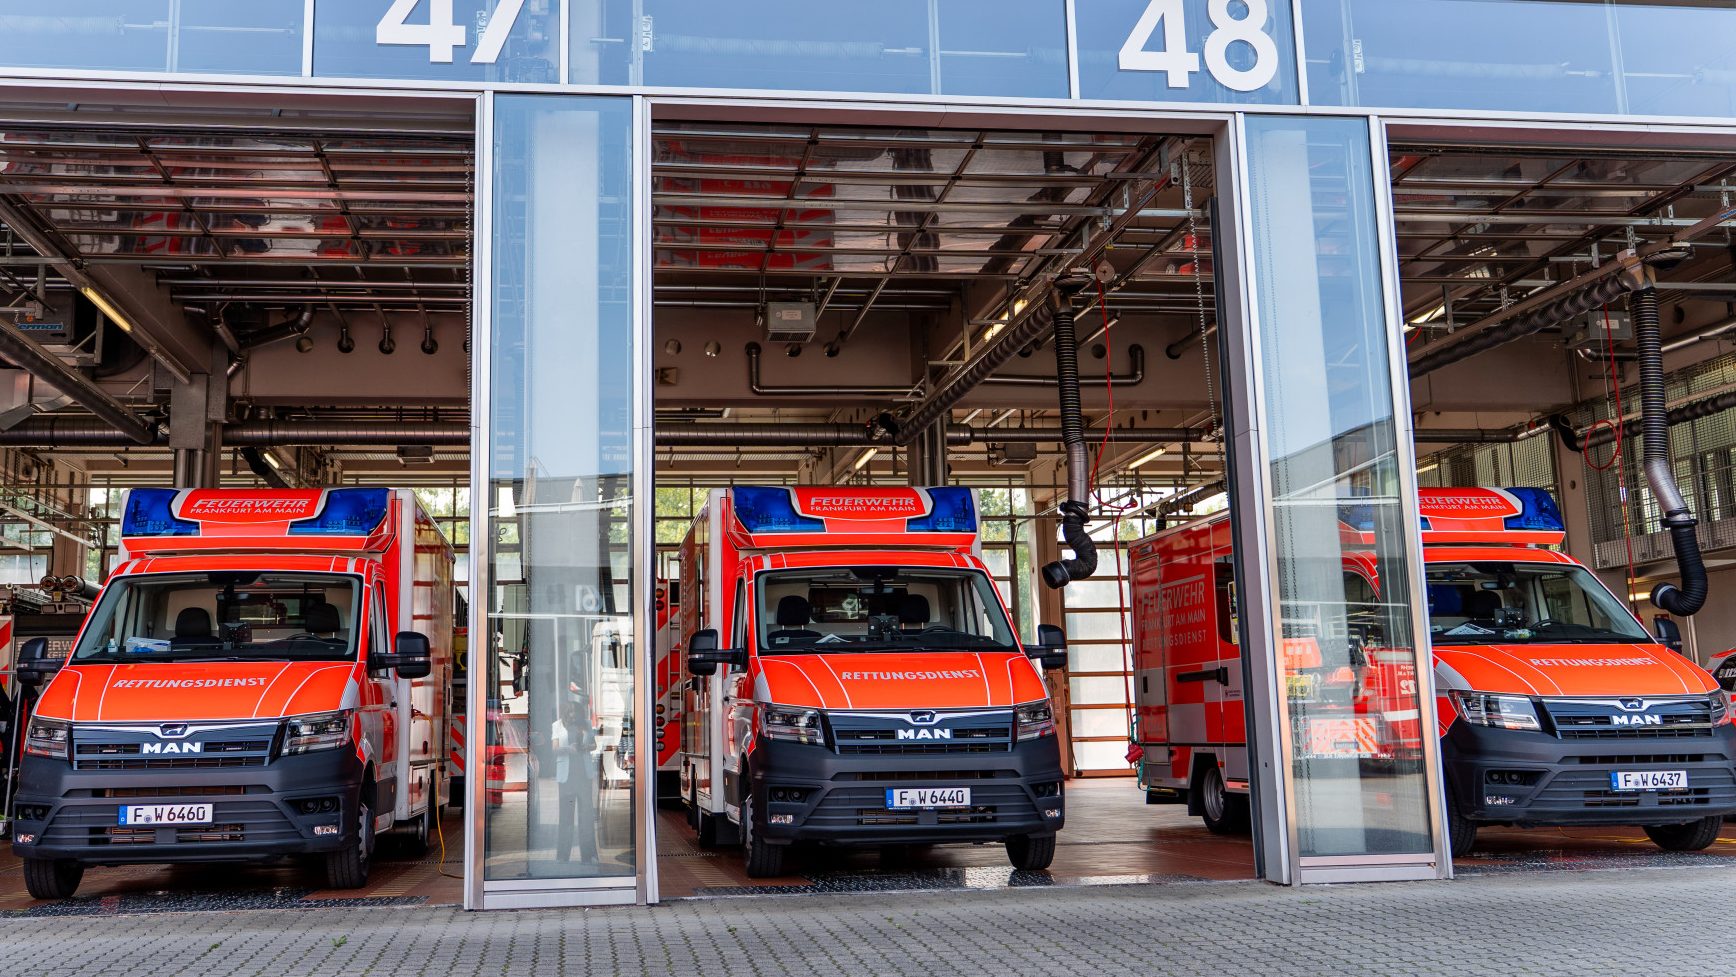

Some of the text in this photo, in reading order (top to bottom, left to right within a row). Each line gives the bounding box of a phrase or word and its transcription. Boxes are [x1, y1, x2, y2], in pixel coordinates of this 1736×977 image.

[1118, 0, 1278, 92] 48
[193, 499, 309, 508] FEUERWEHR
[810, 497, 914, 506] FEUERWEHR
[1419, 496, 1502, 505] EUERWEHR
[1141, 581, 1205, 616] FEUERWEHR
[1141, 614, 1175, 632] FRANKURT
[1188, 607, 1206, 624] MAIN
[1529, 657, 1658, 667] RETTUNGSDIENST
[841, 669, 980, 680] RETTUNGSDIENST
[113, 677, 267, 688] RETTUNGSDIENST
[1612, 714, 1662, 725] MAN
[897, 728, 951, 740] MAN
[142, 742, 202, 754] MAN
